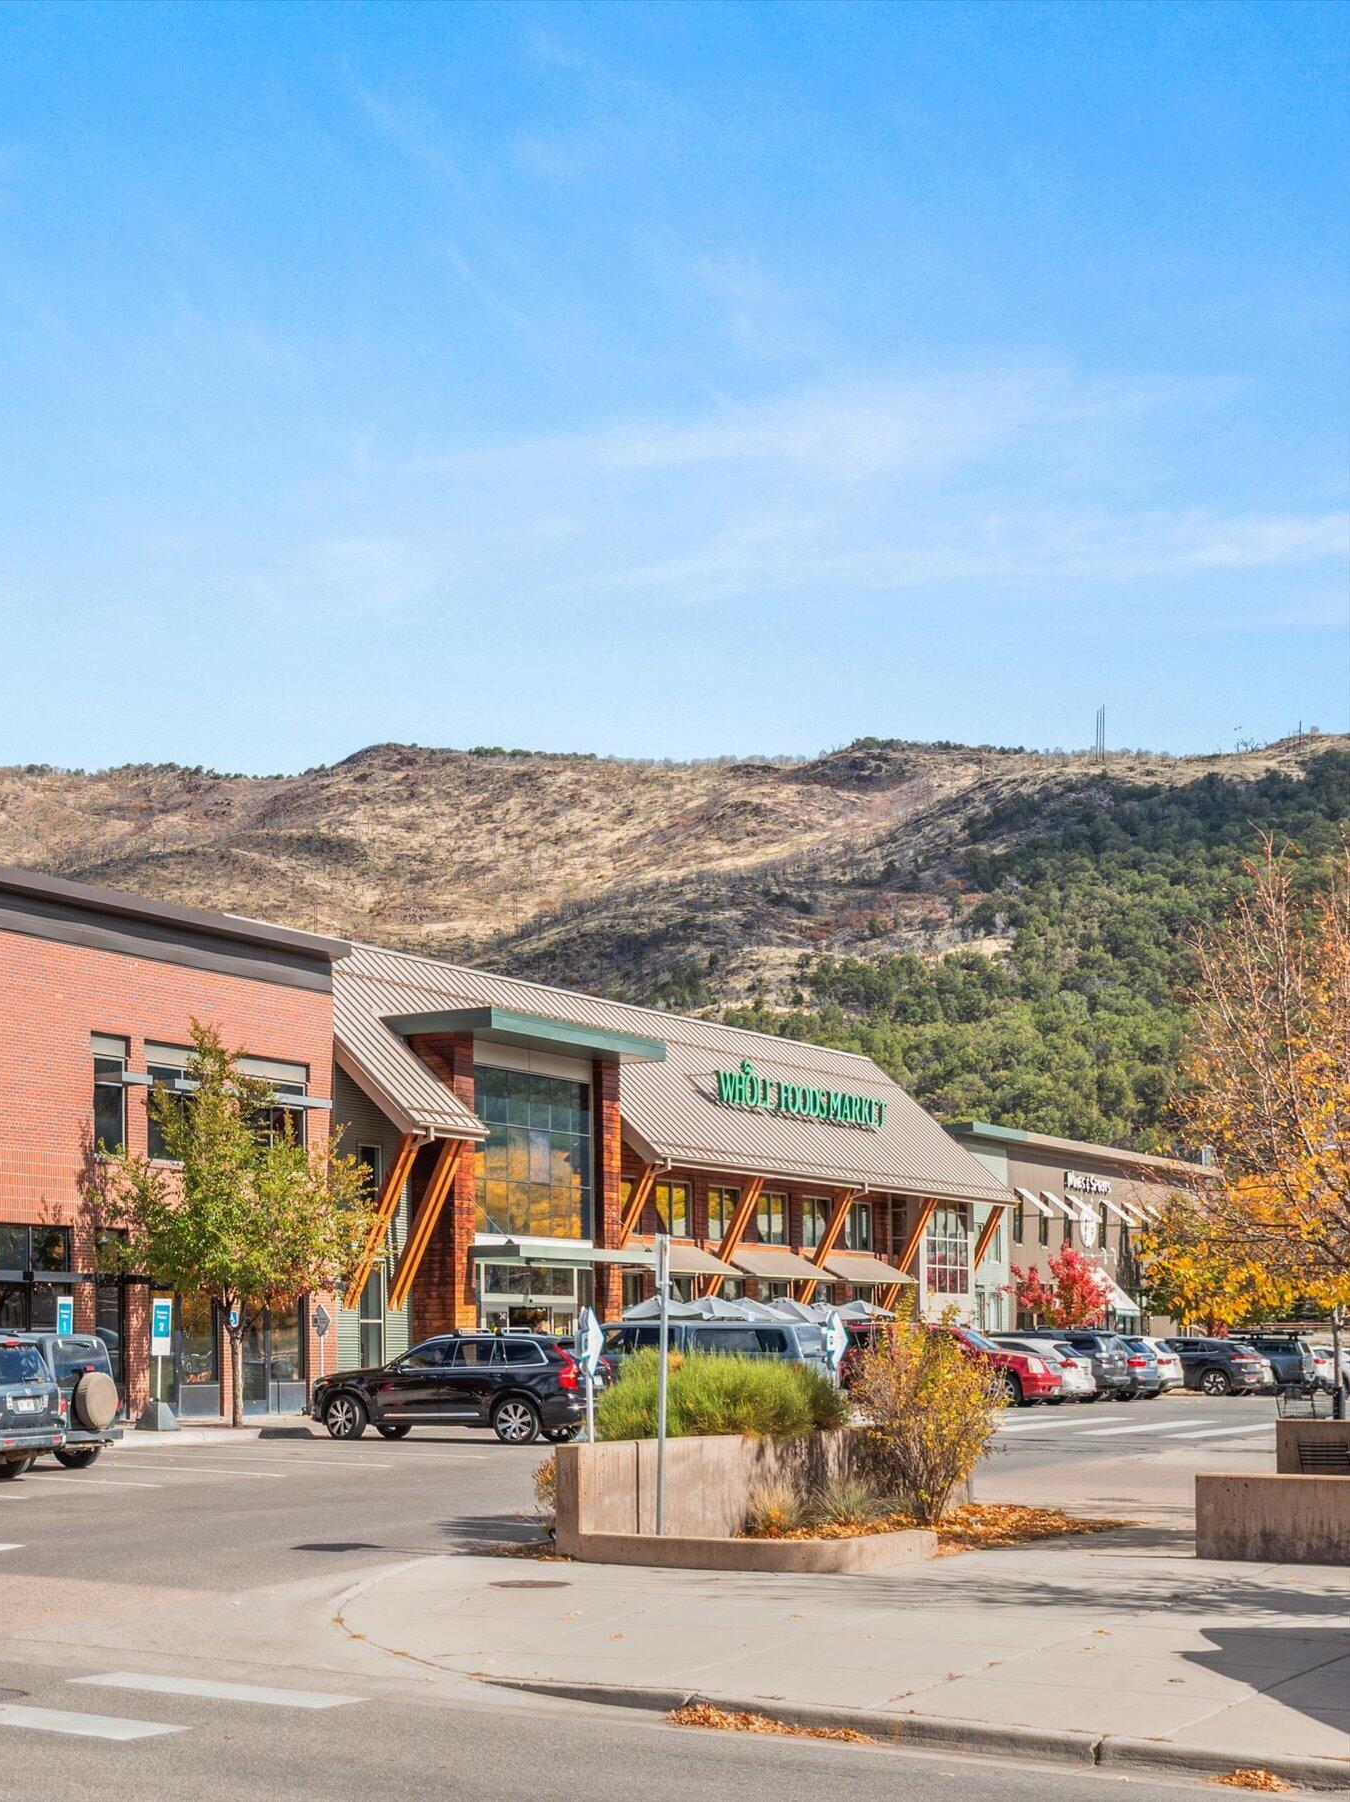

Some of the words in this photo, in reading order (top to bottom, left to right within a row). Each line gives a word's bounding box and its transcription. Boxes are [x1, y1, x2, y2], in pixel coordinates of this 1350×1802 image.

[717, 1069, 776, 1110] WHOLE
[780, 1083, 828, 1118] FOODS
[829, 1091, 887, 1129] MARKET
[158, 1322, 165, 1332] 2
